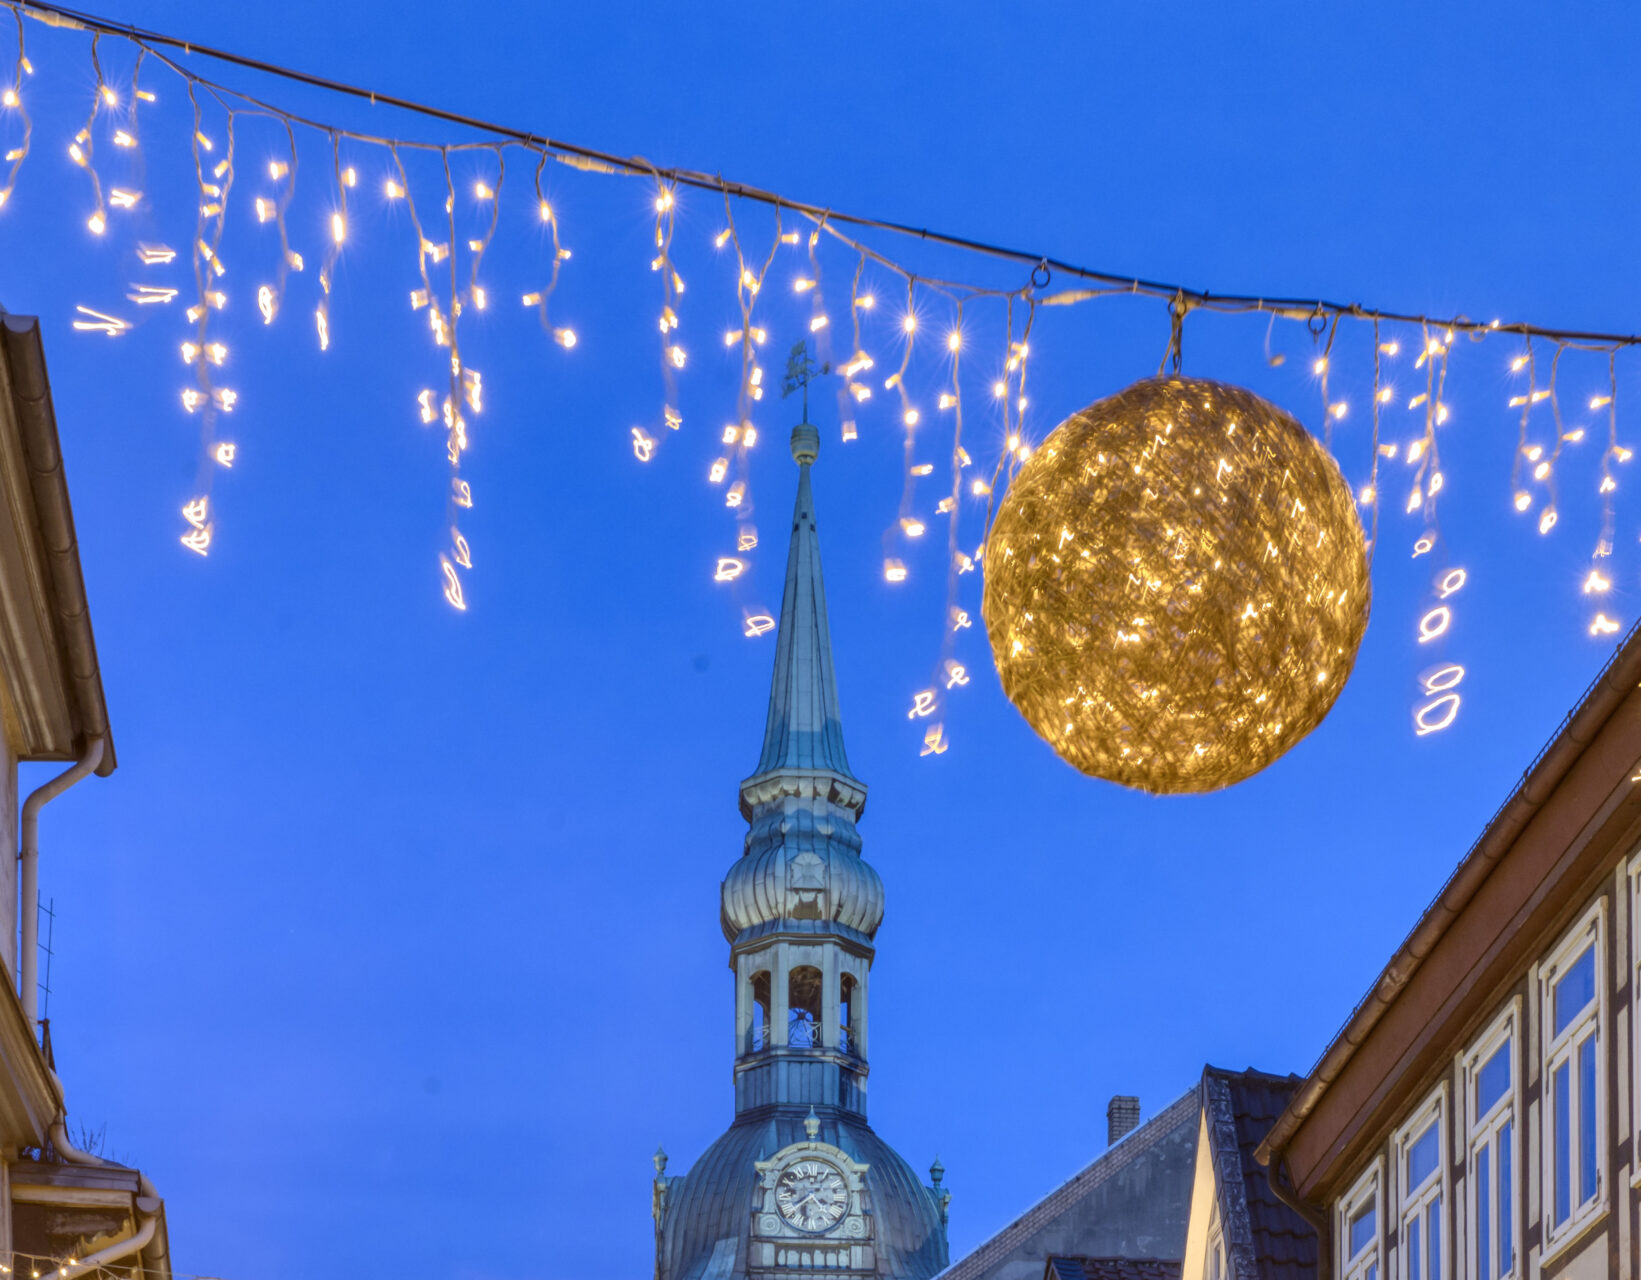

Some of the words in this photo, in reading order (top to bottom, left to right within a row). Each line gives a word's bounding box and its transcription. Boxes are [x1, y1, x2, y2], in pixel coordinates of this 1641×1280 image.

[793, 1166, 805, 1180] XI
[806, 1163, 818, 1176] XII
[830, 1179, 842, 1188] II
[779, 1192, 791, 1200] IX
